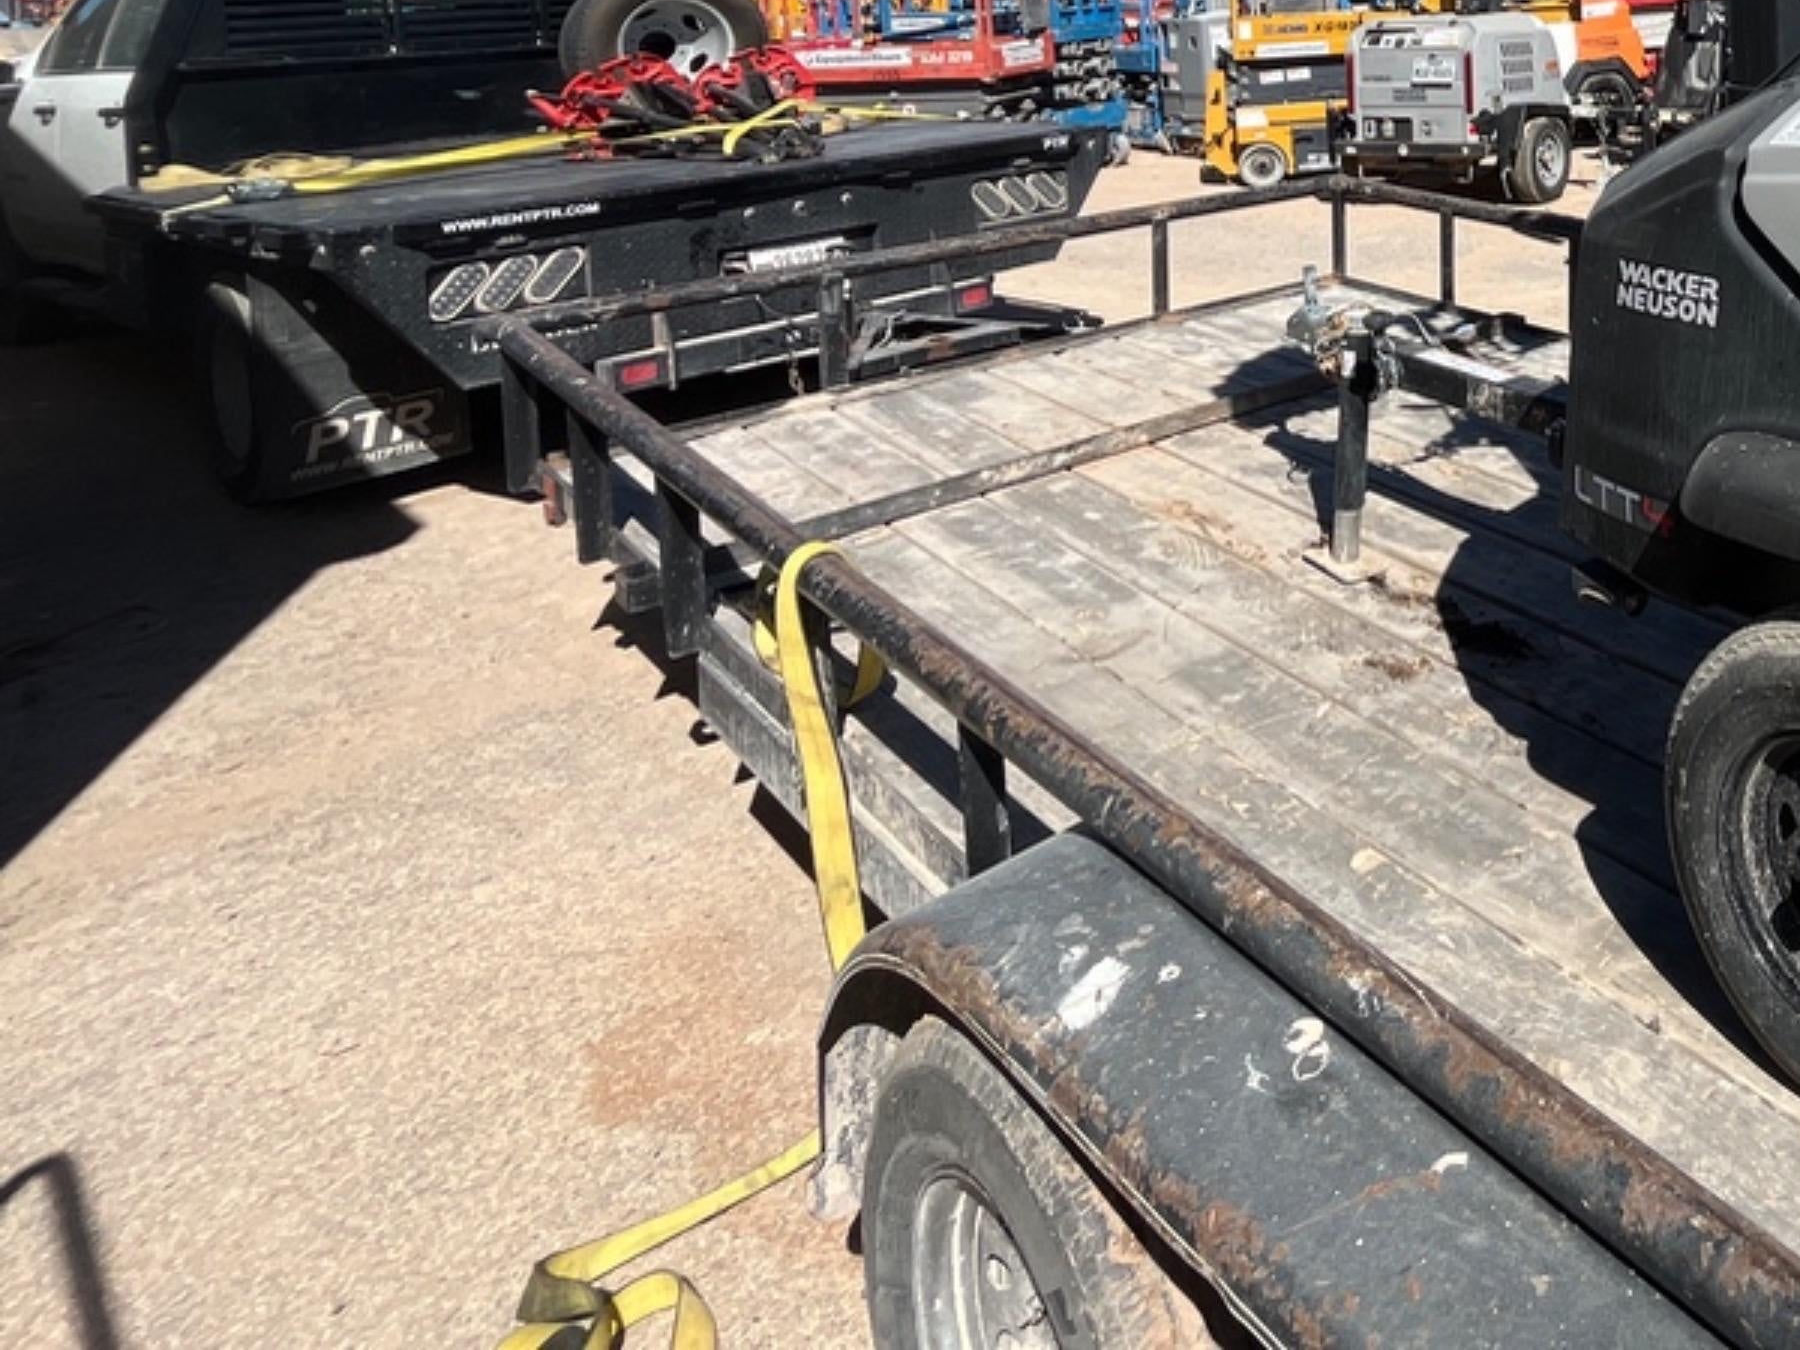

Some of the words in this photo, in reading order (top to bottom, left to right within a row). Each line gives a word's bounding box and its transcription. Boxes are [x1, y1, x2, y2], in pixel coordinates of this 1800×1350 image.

[1619, 258, 1719, 302] WACKER
[1616, 283, 1718, 328] NEUSON
[305, 400, 434, 465] PTR
